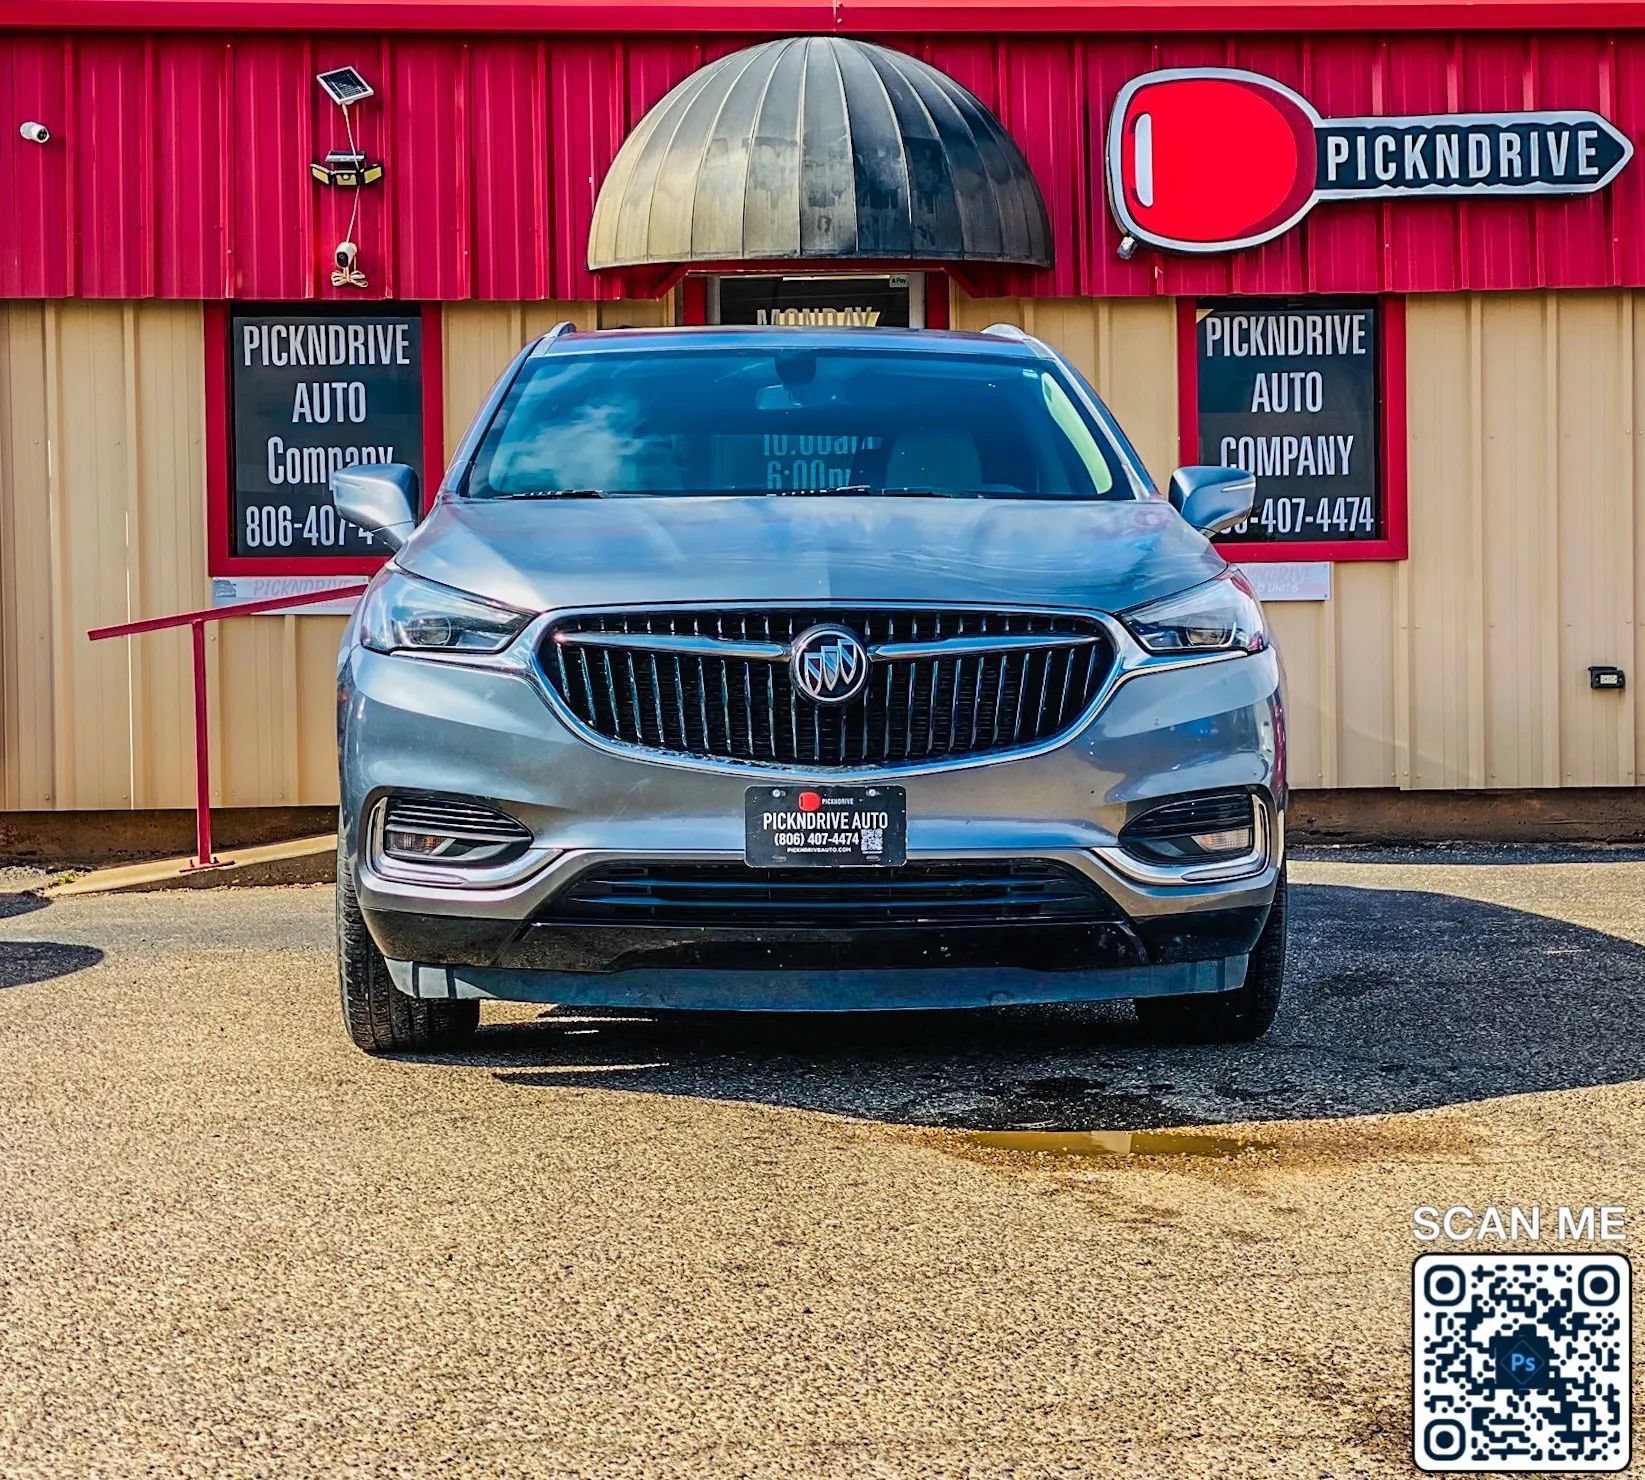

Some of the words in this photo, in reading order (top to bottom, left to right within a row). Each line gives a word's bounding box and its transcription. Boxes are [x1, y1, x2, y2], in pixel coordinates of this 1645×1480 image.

[1327, 129, 1599, 181] PICKNDRIVE
[242, 324, 410, 366] PICKNDRIVE
[1206, 314, 1366, 357] PICKNDRIVE
[291, 381, 366, 423] AUTO
[1251, 371, 1323, 413] AUTO
[1220, 435, 1354, 477] COMPANY
[763, 811, 849, 830] PICKNDRIVE
[852, 811, 888, 829] AUTO
[774, 832, 805, 846] (806)
[807, 832, 859, 845] 407-4474
